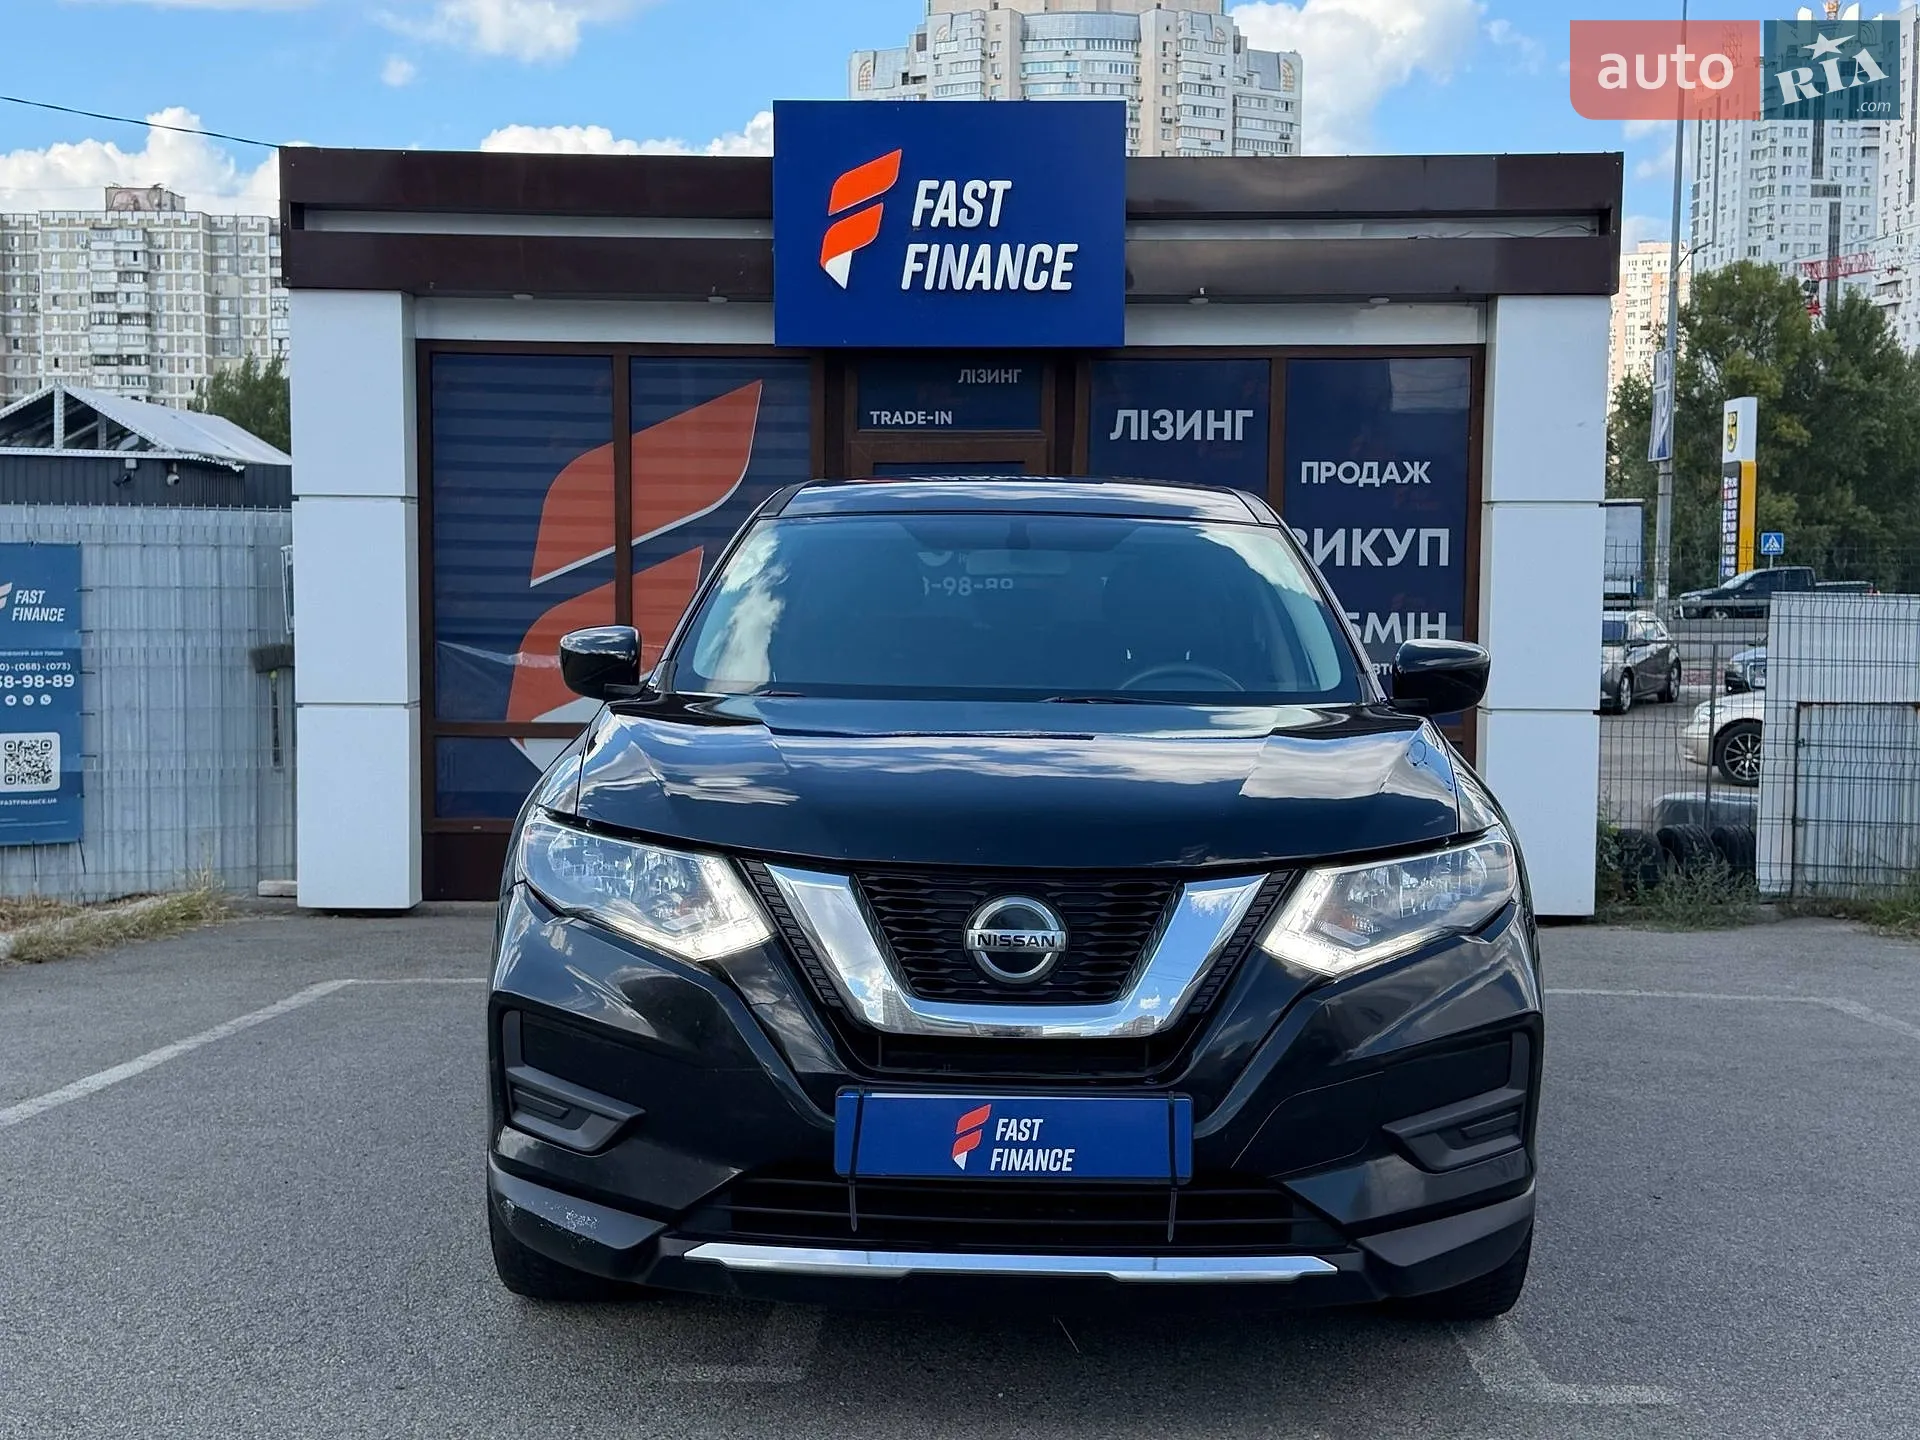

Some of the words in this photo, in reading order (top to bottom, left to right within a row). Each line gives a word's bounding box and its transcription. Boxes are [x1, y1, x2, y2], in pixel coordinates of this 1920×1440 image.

[911, 179, 1012, 228] FAST
[901, 243, 1078, 291] FINANCE
[957, 368, 1022, 384] ЛІЗИНГ
[869, 410, 953, 425] TRADE-IN
[1109, 408, 1254, 441] ЛІЗИНГ
[1301, 460, 1432, 488] ПРОДАЖ
[14, 589, 46, 605] FAST
[11, 607, 66, 622] FINANCE
[977, 933, 1056, 948] NISSAN
[995, 1118, 1043, 1142] FAST
[990, 1148, 1076, 1172] FINANCE
